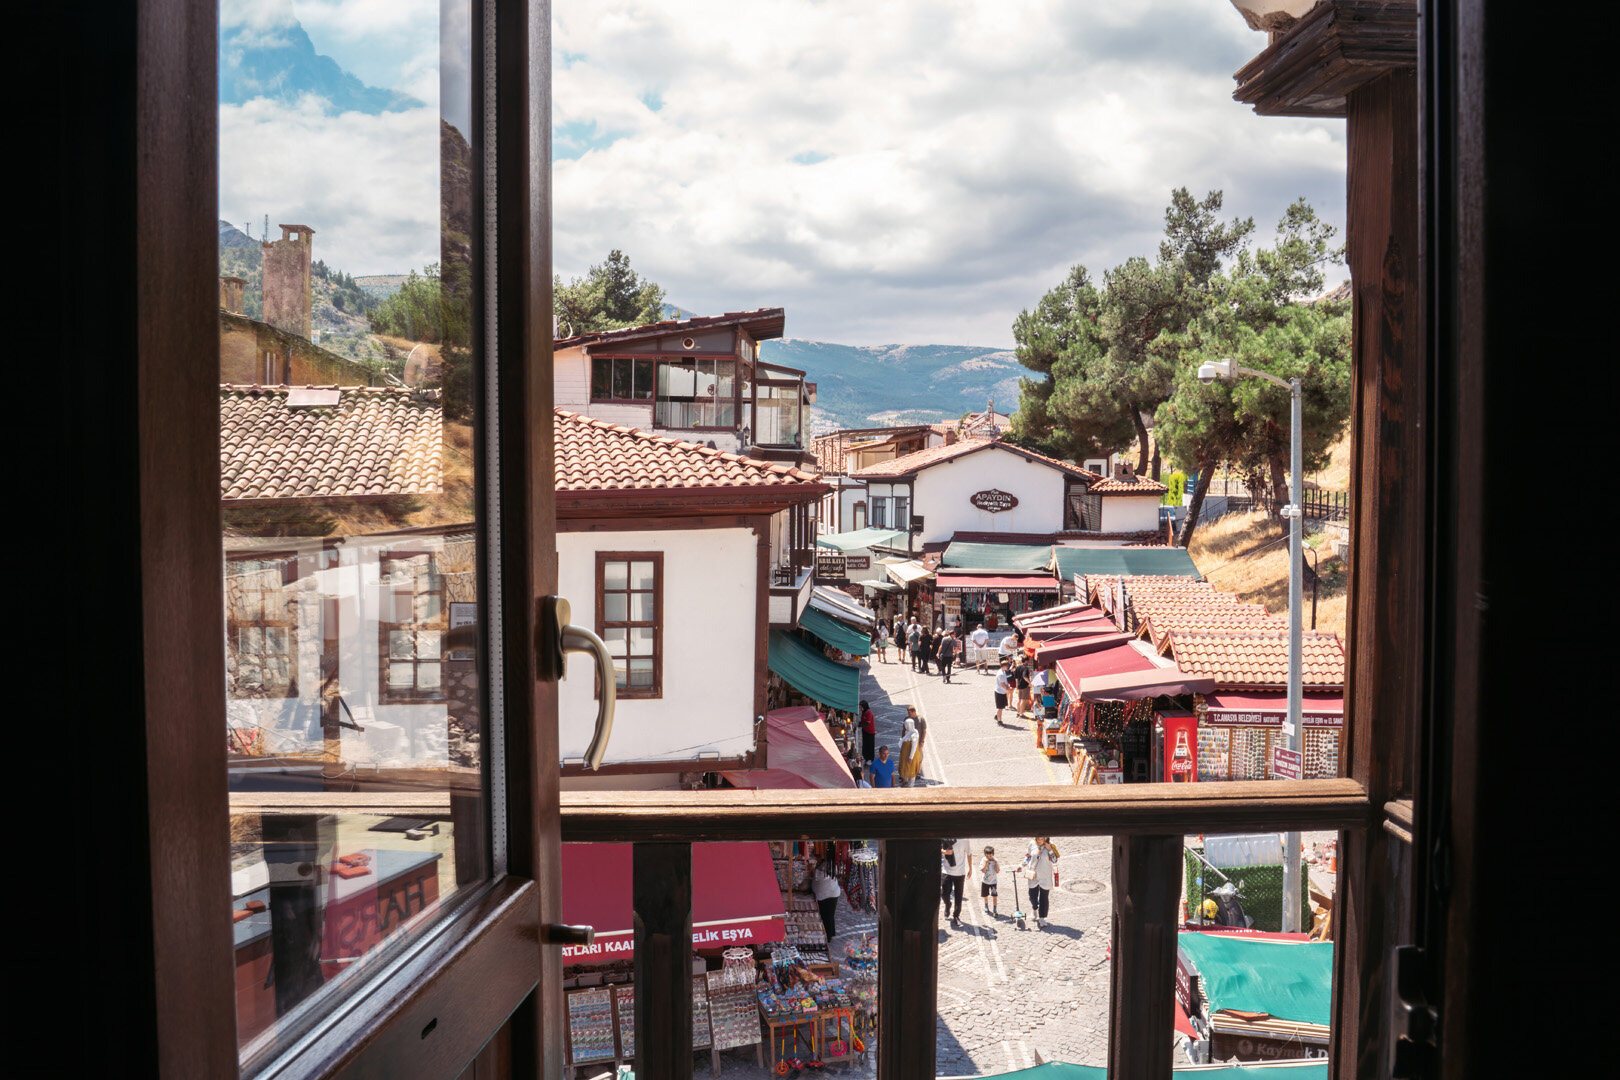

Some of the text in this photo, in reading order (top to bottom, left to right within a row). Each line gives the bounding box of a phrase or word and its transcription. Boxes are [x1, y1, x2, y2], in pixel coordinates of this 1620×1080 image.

[1172, 760, 1192, 770] Coca-Cola
[722, 928, 753, 942] EŞYA
[1256, 1043, 1313, 1059] Kaymak
